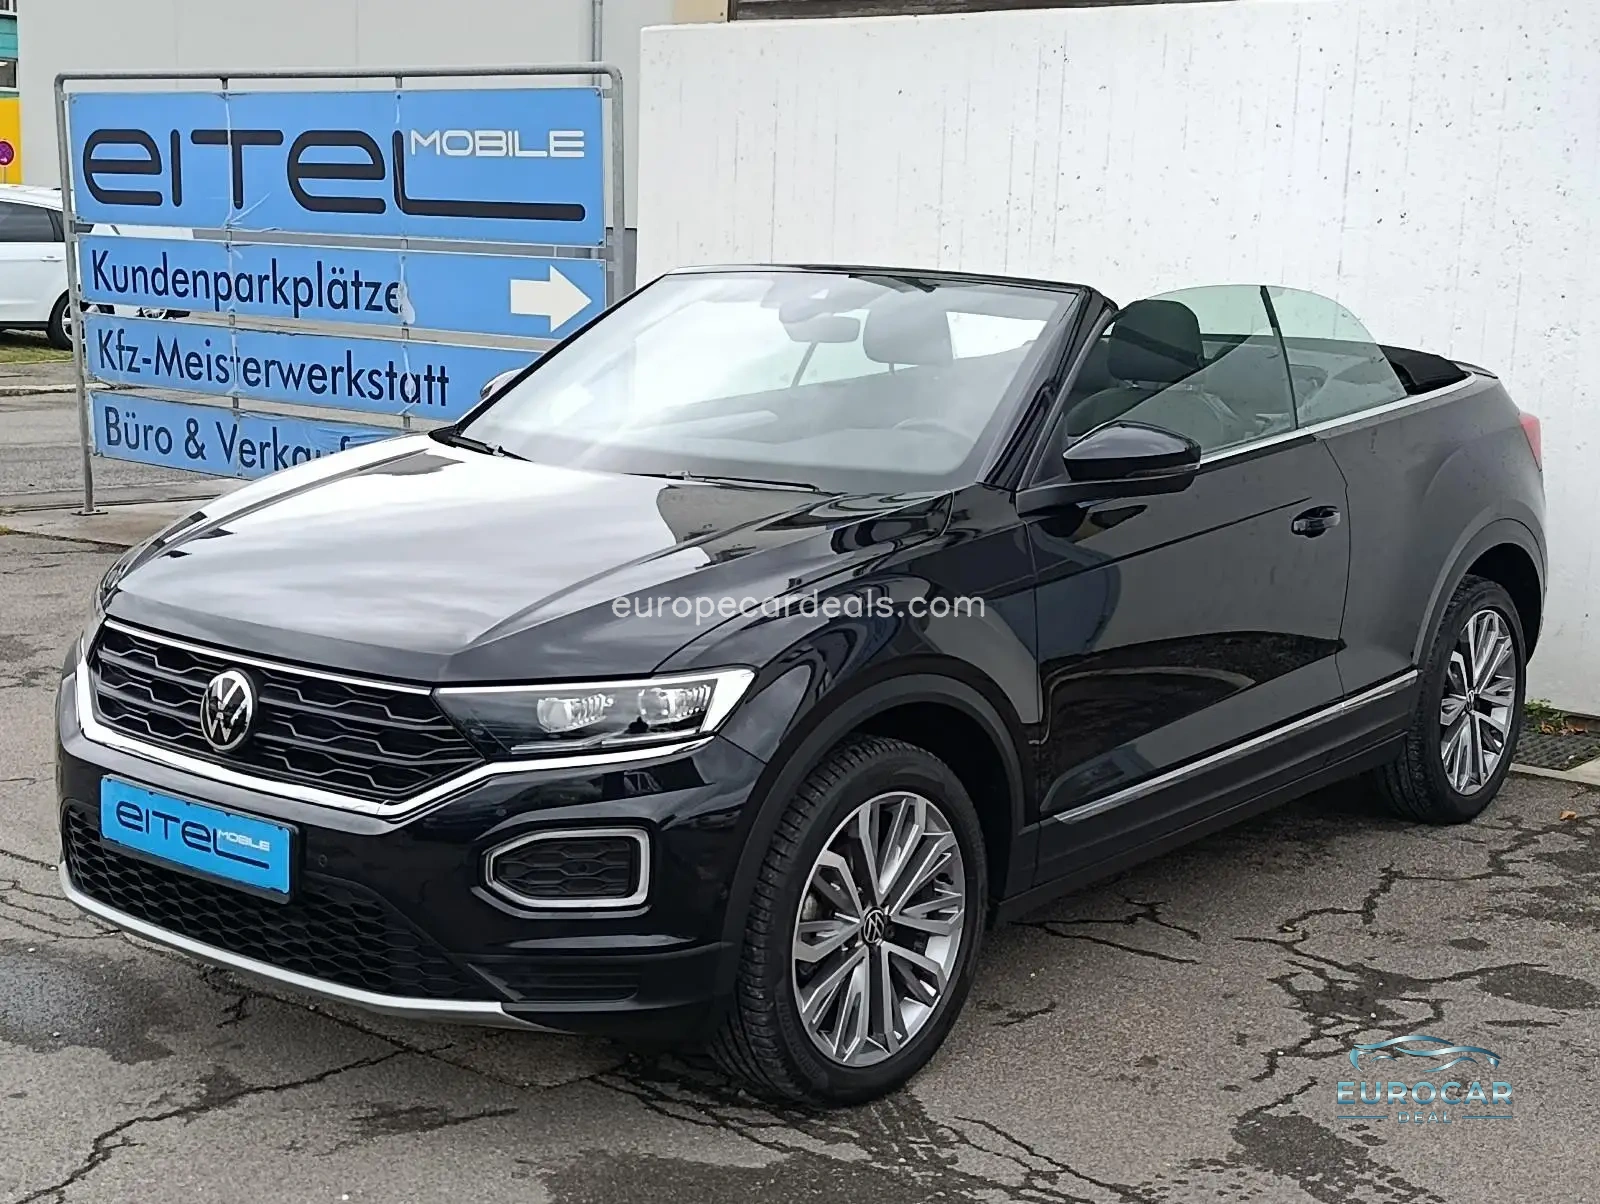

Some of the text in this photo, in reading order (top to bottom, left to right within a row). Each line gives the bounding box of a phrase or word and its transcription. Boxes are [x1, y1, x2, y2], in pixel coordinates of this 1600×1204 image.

[410, 129, 585, 158] MOBILE
[91, 250, 403, 319] Kundenparkplätze
[98, 328, 450, 408] Kfz-Meisterwerkstatt
[105, 406, 173, 455] Büro
[184, 417, 207, 461] &
[218, 828, 271, 852] MOBILE
